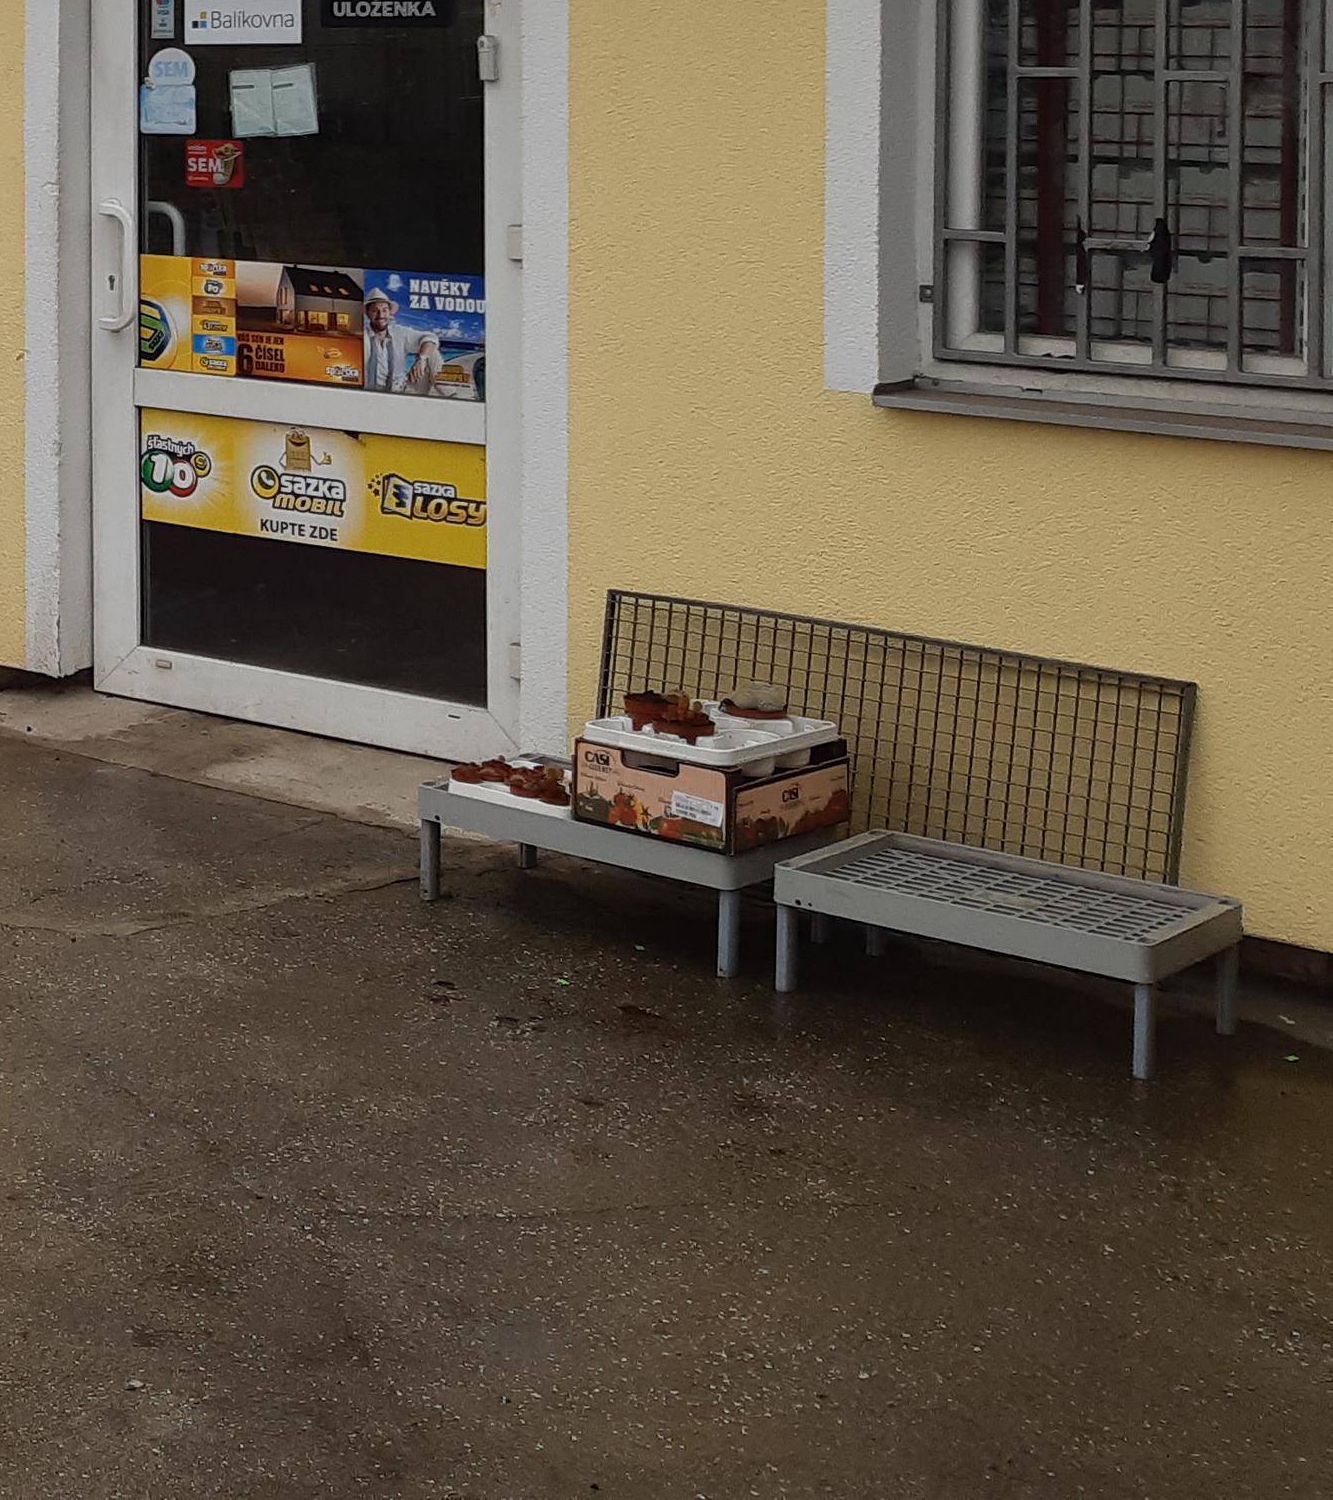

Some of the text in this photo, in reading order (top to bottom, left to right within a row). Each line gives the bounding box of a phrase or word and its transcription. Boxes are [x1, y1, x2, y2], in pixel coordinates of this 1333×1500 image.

[210, 10, 295, 29] Balíkovna
[409, 278, 471, 297] NAVĚKY
[409, 295, 486, 314] ZA VODOU
[237, 343, 253, 374] 6
[255, 344, 285, 362] ČÍSEL
[260, 518, 338, 542] KUPTE ZDE
